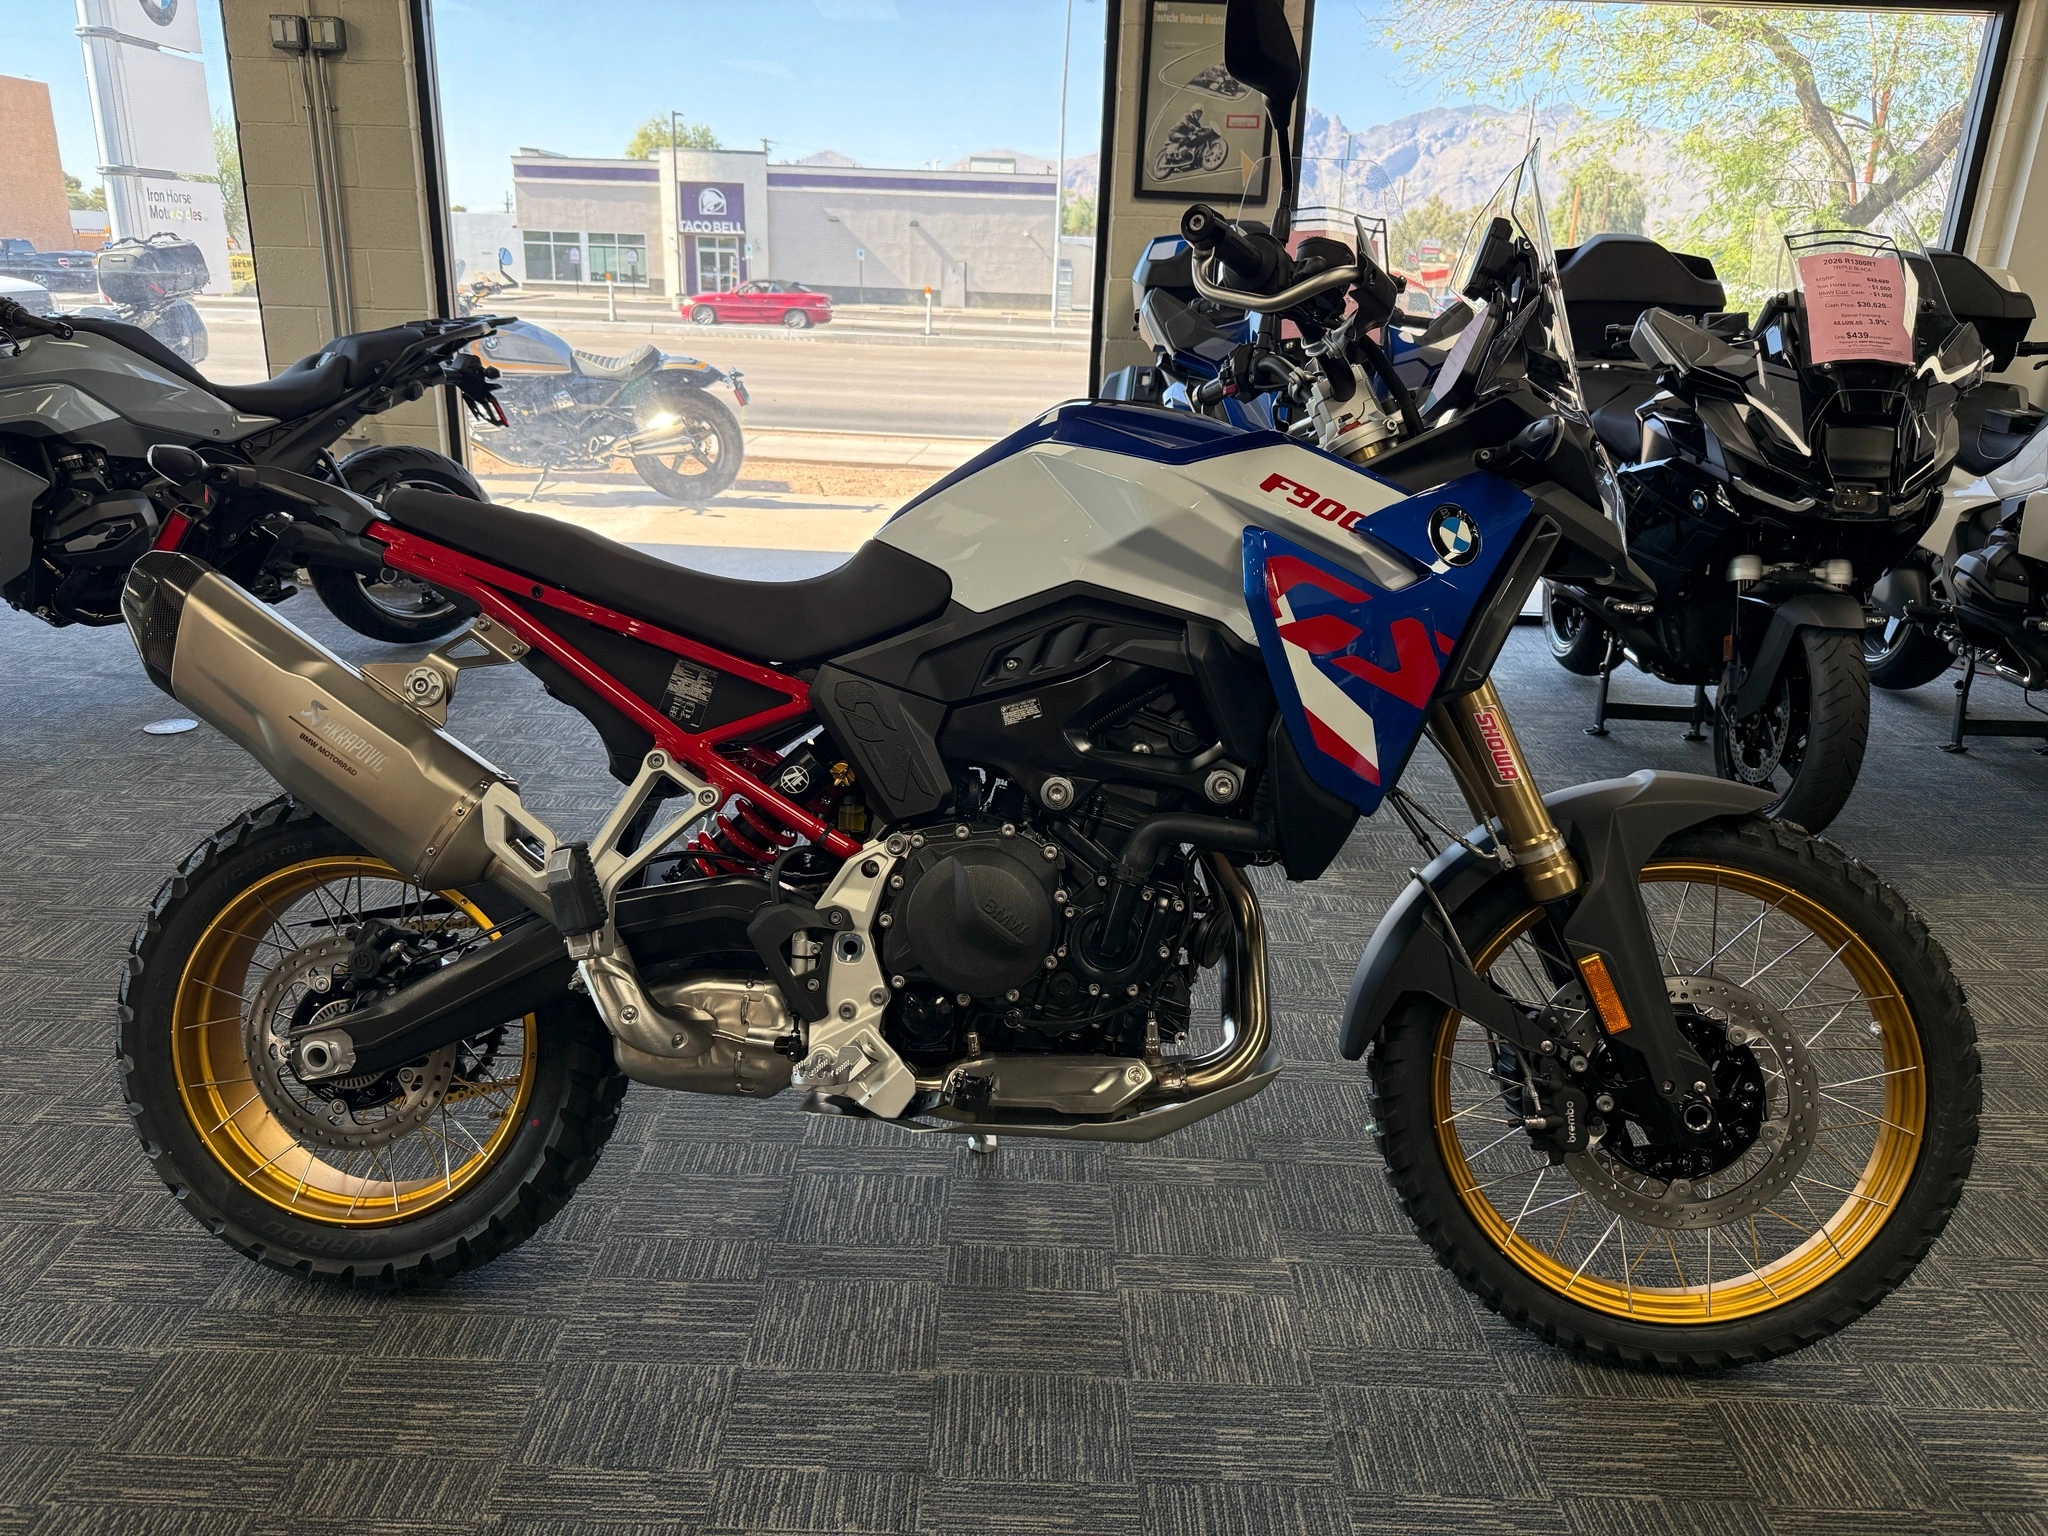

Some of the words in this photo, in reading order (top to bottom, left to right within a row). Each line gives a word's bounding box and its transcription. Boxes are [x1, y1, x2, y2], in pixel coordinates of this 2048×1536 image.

[147, 187, 165, 203] Iron
[166, 189, 192, 204] Horse
[680, 220, 713, 232] TACO
[713, 221, 746, 235] BELL
[1823, 258, 1843, 266] 2026
[1844, 258, 1877, 267] R1300RT
[1856, 301, 1887, 309] $30,620
[299, 732, 319, 749] BMW
[317, 745, 358, 777] MOTORRAD
[1474, 711, 1520, 781] SHOWA
[980, 898, 1031, 937] BMW
[1565, 1101, 1577, 1143] brembo
